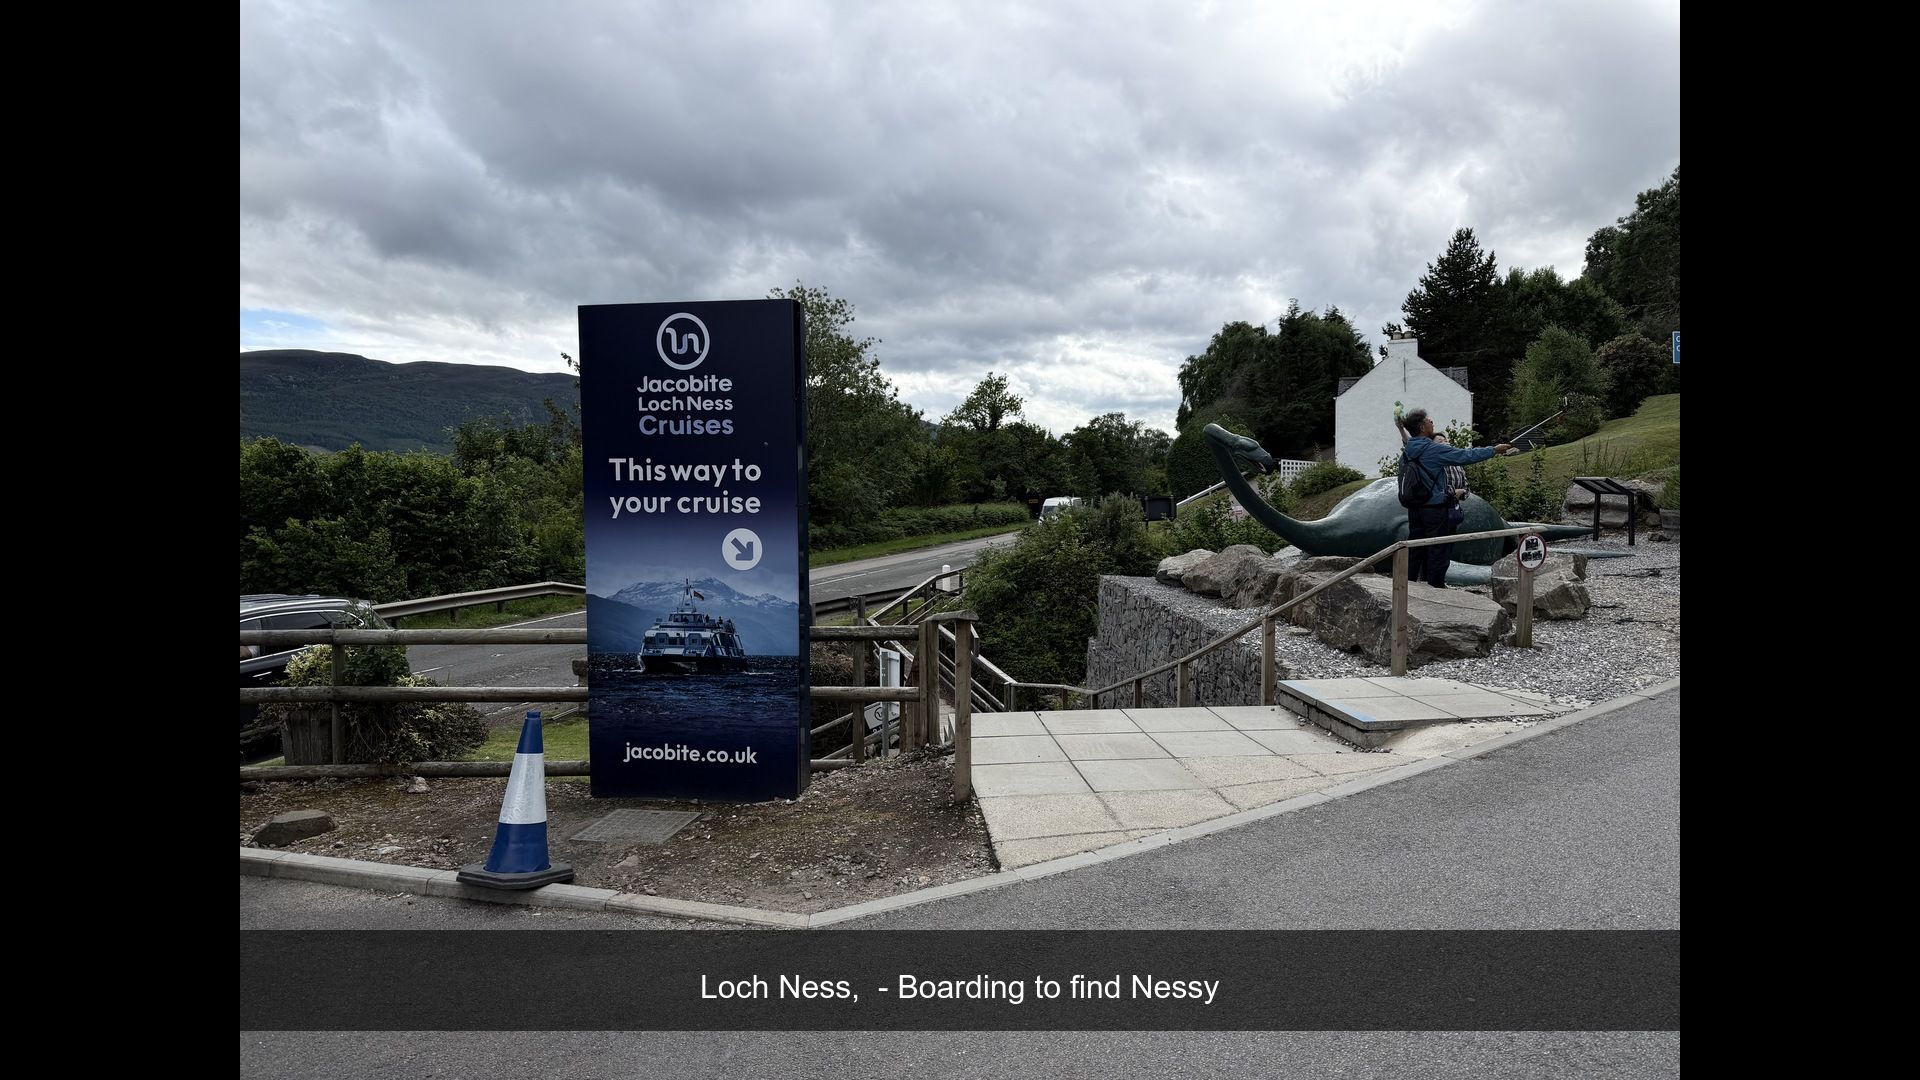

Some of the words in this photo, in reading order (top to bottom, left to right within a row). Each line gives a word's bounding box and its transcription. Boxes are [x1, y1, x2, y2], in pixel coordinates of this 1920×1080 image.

[637, 375, 733, 393] Jacobite
[638, 396, 684, 411] Loch
[687, 396, 733, 411] Ness
[639, 415, 734, 435] Cruises
[608, 458, 667, 482] This
[670, 464, 728, 488] way
[732, 458, 762, 482] to
[609, 496, 672, 519] your
[676, 490, 761, 514] cruise
[623, 742, 758, 764] jacobite.co.uk
